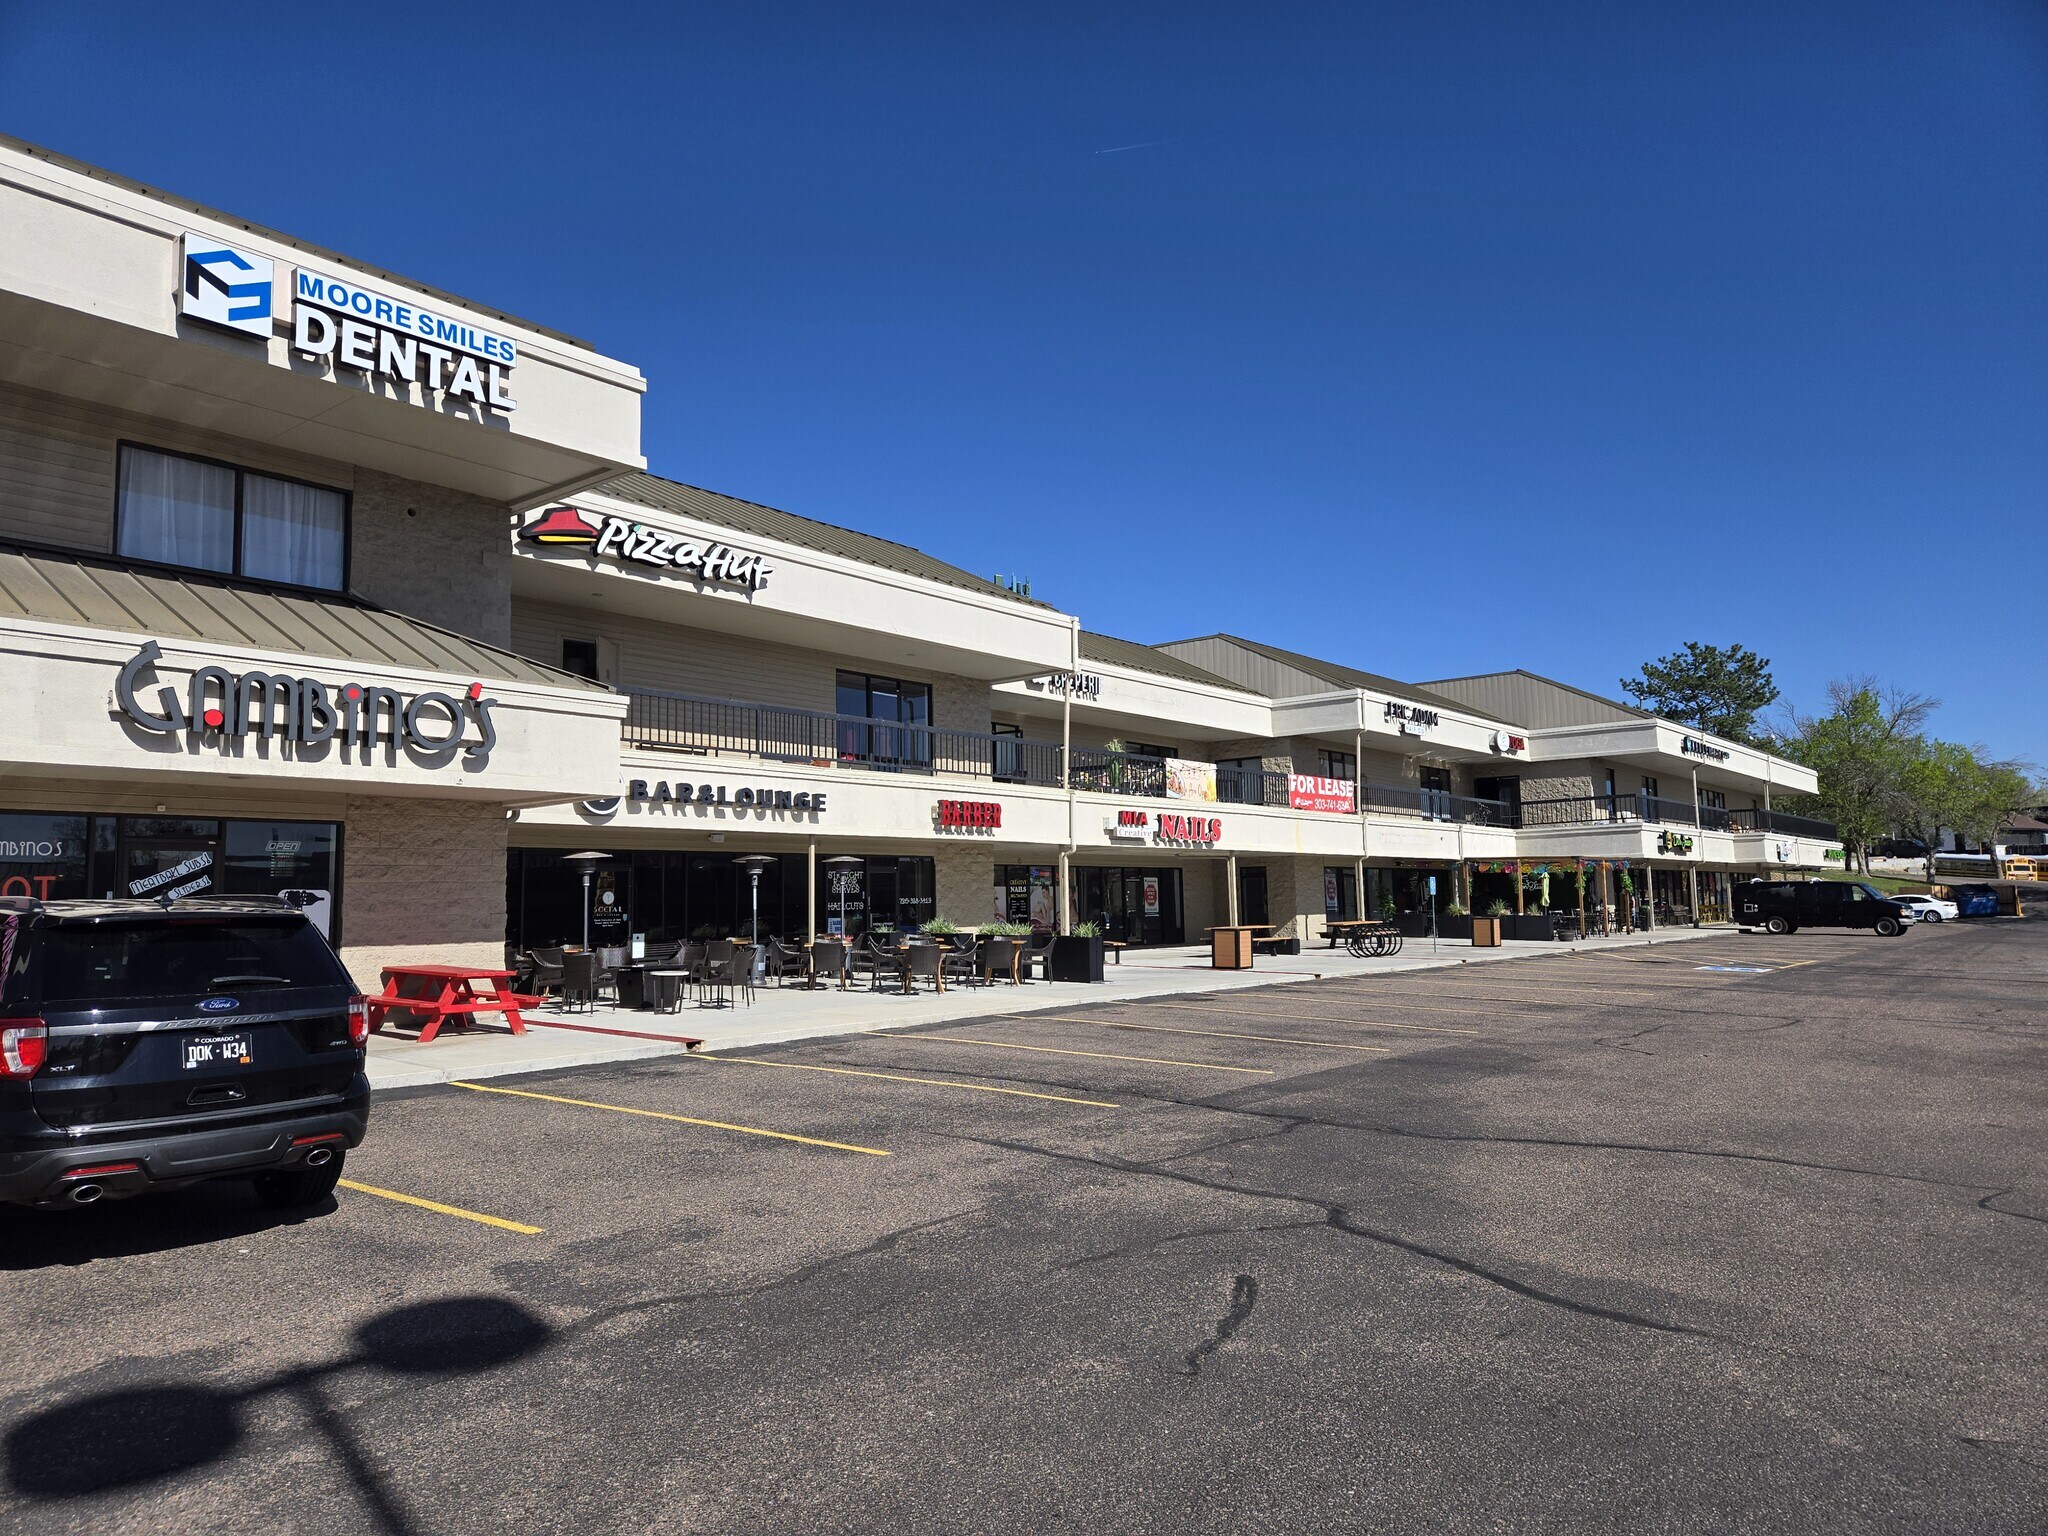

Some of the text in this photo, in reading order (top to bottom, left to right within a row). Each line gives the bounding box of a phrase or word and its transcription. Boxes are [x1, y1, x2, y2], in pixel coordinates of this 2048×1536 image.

[299, 273, 515, 362] MOORE SMILES
[294, 303, 518, 412] DENTAL
[593, 516, 778, 592] Pizza Hut
[1290, 774, 1354, 798] FOR LEASE
[938, 800, 1002, 828] BARBER
[1118, 810, 1148, 826] MIA
[1118, 828, 1152, 838] Creative
[1158, 814, 1222, 842] NAILS
[267, 842, 299, 850] OPEN
[208, 999, 231, 1009] Ford
[200, 1036, 234, 1044] COLORADO
[50, 1064, 76, 1072] XLT
